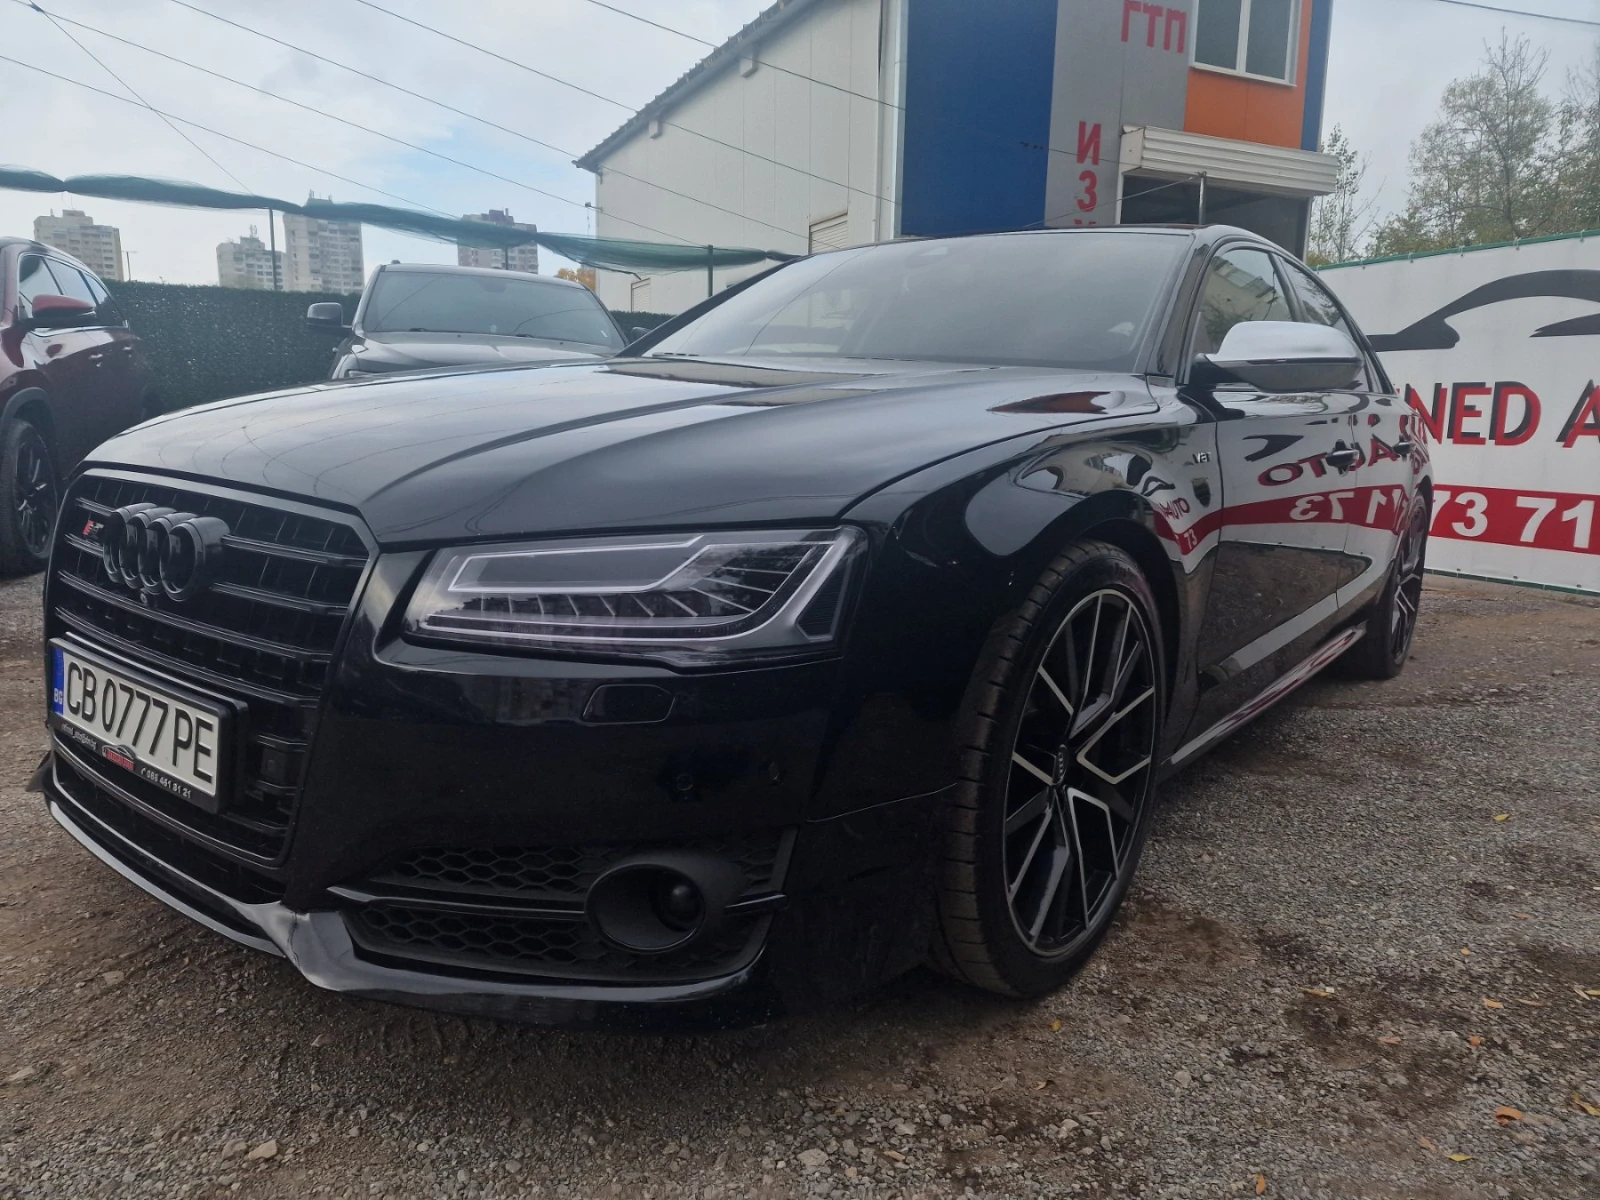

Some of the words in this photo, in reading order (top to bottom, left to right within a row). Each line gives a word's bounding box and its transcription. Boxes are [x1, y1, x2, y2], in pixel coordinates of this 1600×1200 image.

[1121, 0, 1187, 53] ГТП
[1074, 121, 1101, 225] ИЗ
[1397, 381, 1541, 445] NED
[1430, 490, 1488, 537] 73
[1516, 495, 1594, 549] 71
[54, 688, 64, 704] BG
[102, 678, 168, 755] 0777
[172, 708, 214, 785] PE
